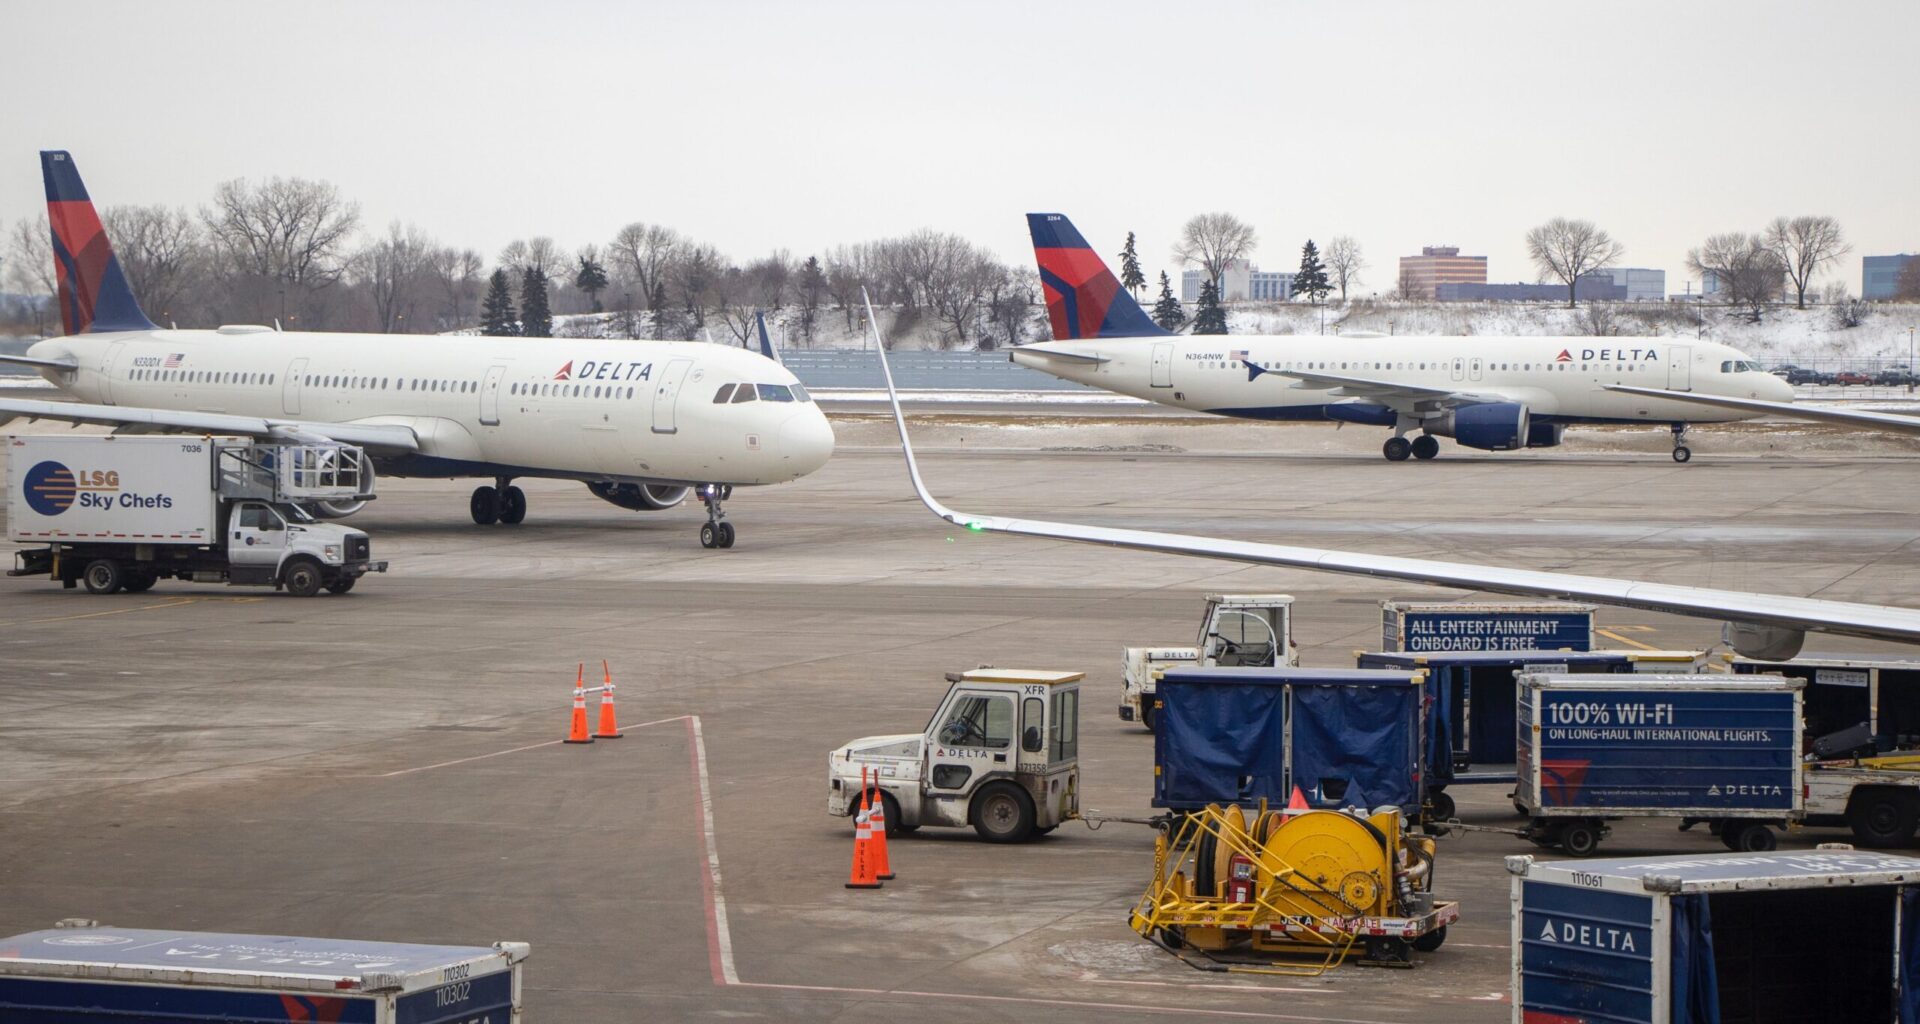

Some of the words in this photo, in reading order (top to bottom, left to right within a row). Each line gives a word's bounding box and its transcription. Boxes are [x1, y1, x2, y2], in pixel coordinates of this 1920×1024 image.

[1185, 353, 1224, 361] N364NW
[1581, 349, 1658, 361] DELTA
[578, 360, 653, 382] DELTA
[181, 444, 202, 453] 7036
[80, 470, 119, 487] LSG
[80, 492, 114, 511] Sky
[119, 493, 173, 508] Chefs
[1411, 620, 1436, 634] ALL
[1440, 620, 1559, 635] ENTERTAINMENT
[1411, 636, 1482, 650] ONBOARD
[1485, 637, 1498, 650] IS
[1502, 637, 1539, 650] FREE.
[1024, 685, 1045, 695] XFR
[1549, 702, 1610, 724] 100%
[1616, 703, 1673, 725] WI-FI
[1549, 729, 1565, 740] ON
[1568, 729, 1631, 740] LONG-HAUL
[1633, 730, 1721, 741] INTERNATIONAL
[1724, 731, 1771, 742] FLIGHTS.
[949, 749, 988, 759] DELTA
[1020, 763, 1047, 773] 171358
[1726, 785, 1782, 796] DELTA
[1571, 872, 1603, 888] 111061
[1281, 916, 1303, 925] JET
[1304, 916, 1313, 925] A
[1563, 923, 1636, 952] DELTA
[166, 948, 335, 966] DELTA
[444, 963, 470, 981] 110302
[435, 981, 471, 1008] 110302
